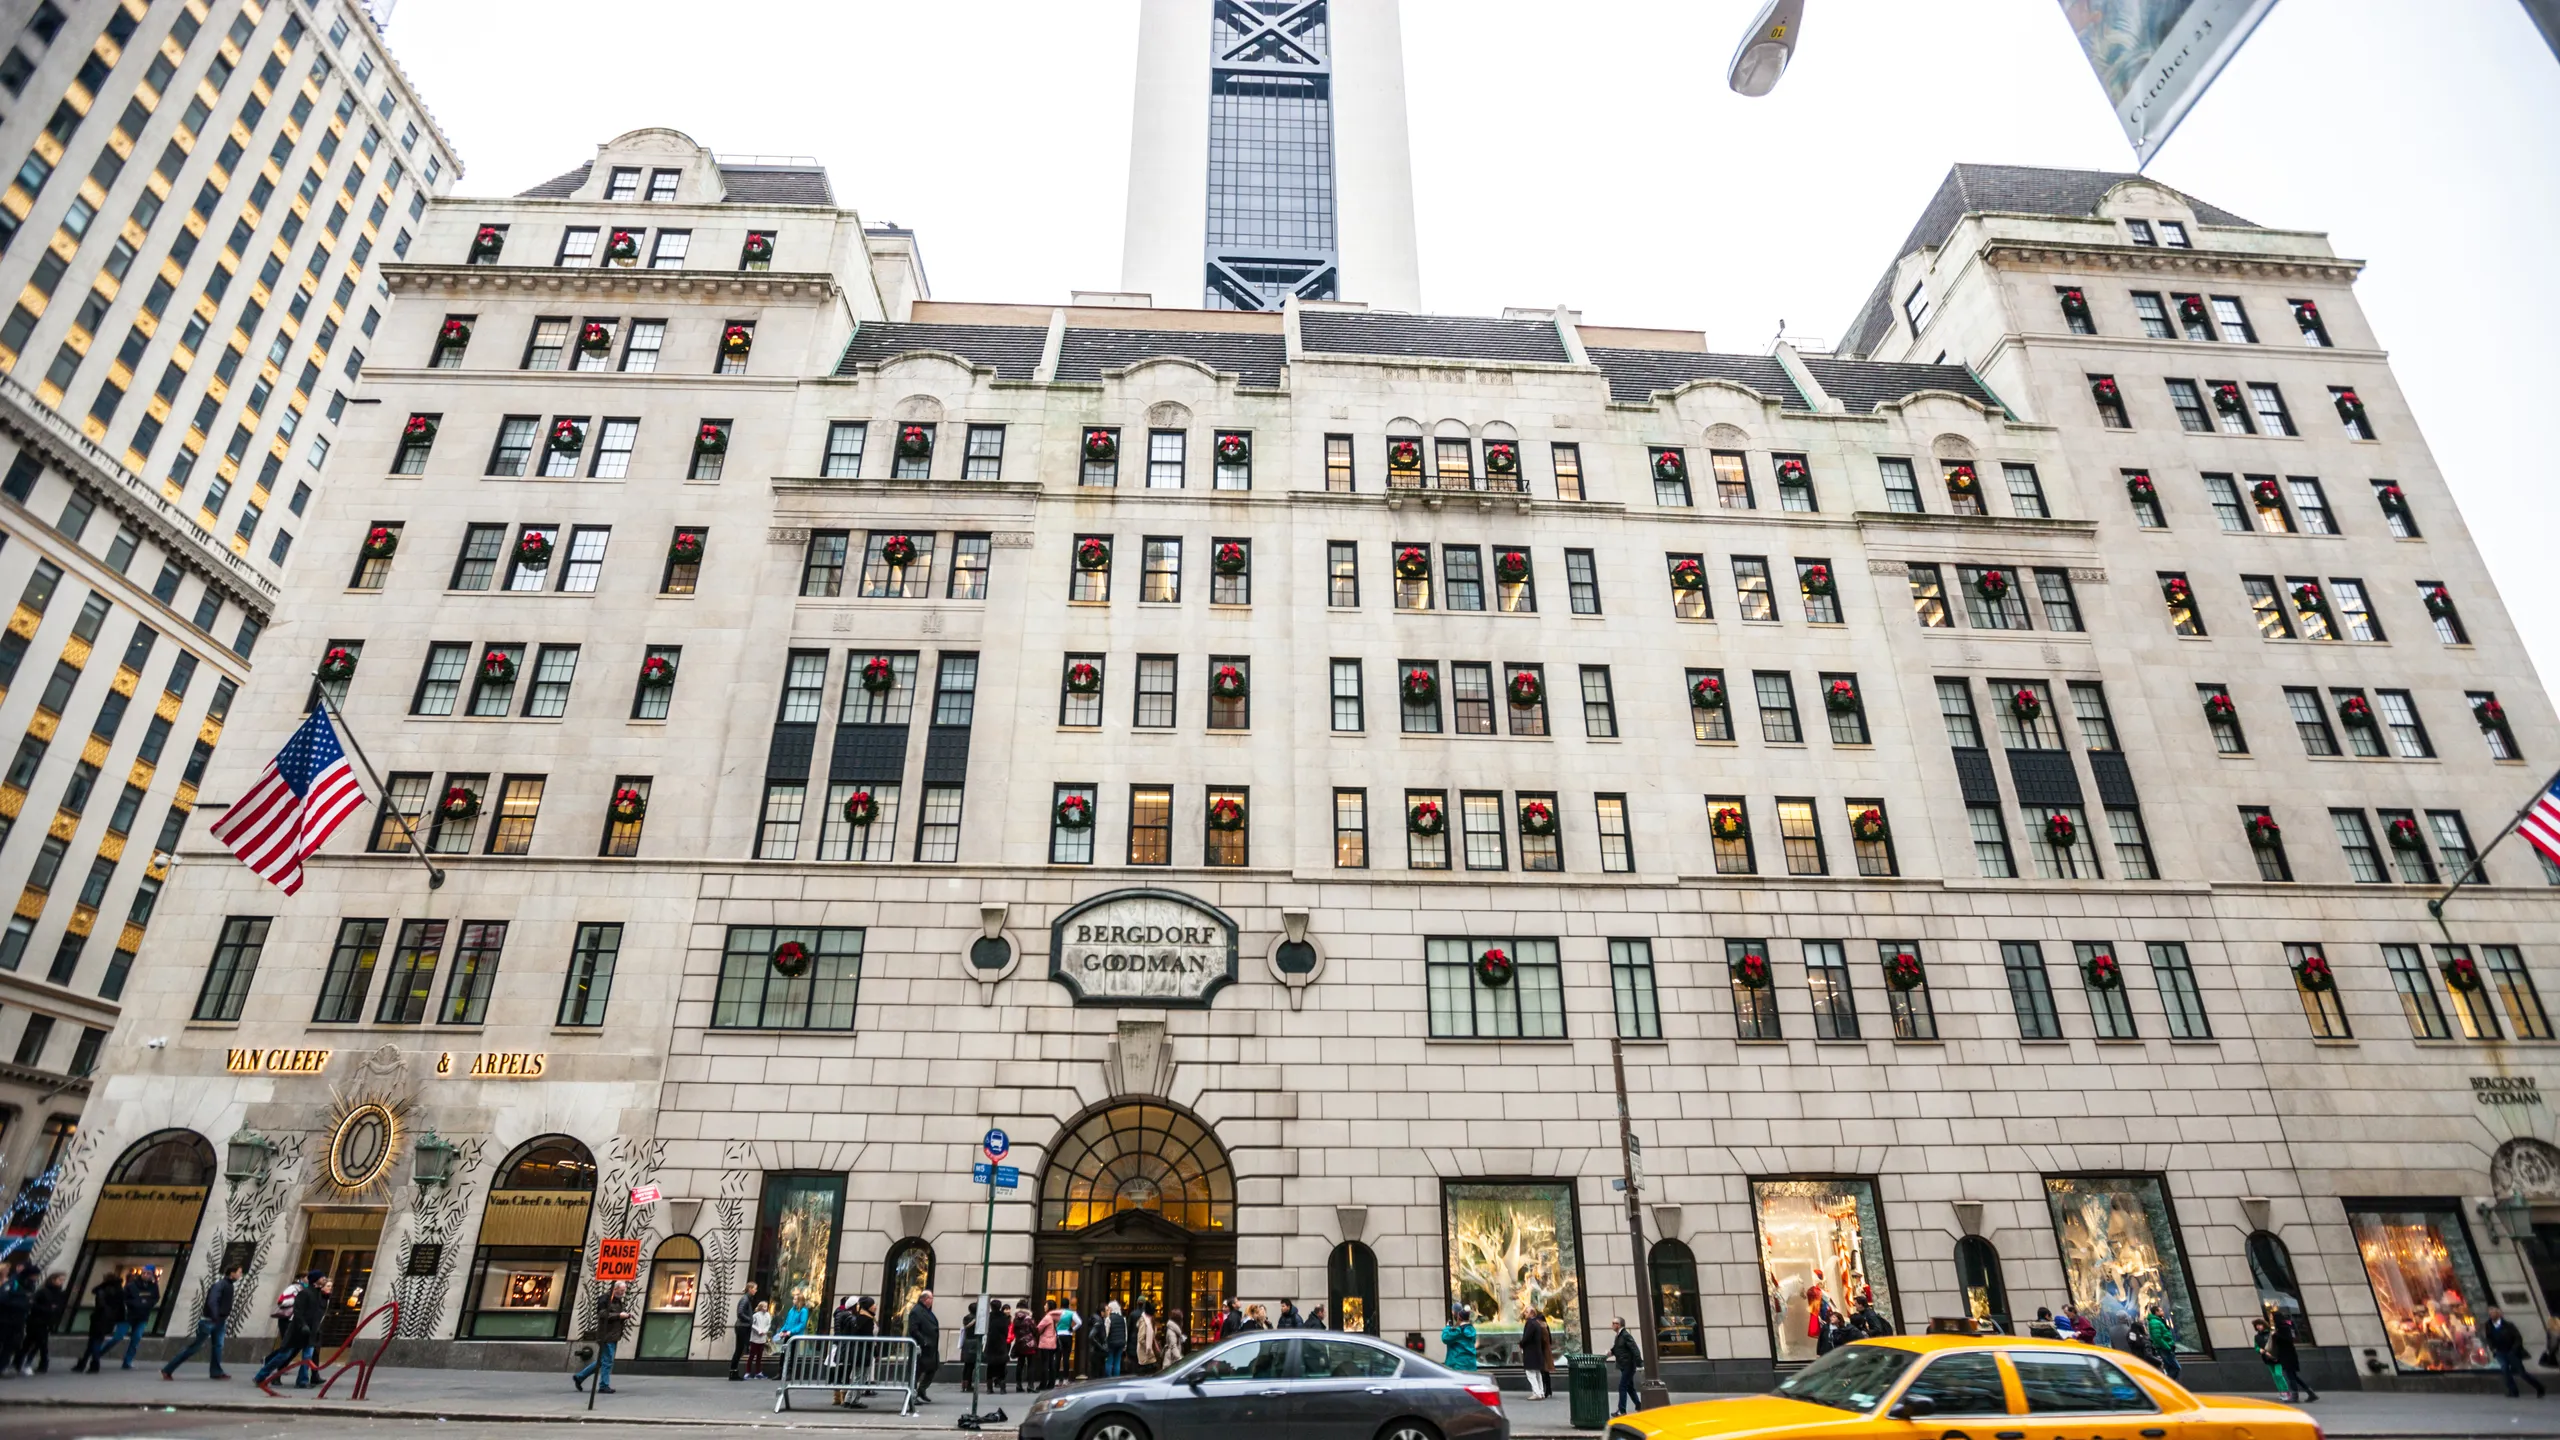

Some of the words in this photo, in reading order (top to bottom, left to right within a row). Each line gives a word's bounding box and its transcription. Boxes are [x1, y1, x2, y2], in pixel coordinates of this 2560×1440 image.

[2130, 45, 2191, 124] October
[1076, 925, 1216, 944] BERGDORF
[1083, 954, 1207, 973] GOODMAN
[226, 1049, 264, 1070] VAN
[266, 1049, 329, 1071] CLEEF
[437, 1052, 450, 1073] &
[470, 1053, 544, 1075] ARPELS
[2469, 1076, 2536, 1090] BERGDORF
[2477, 1092, 2543, 1105] GOODMAN
[490, 1195, 509, 1205] Van
[512, 1195, 542, 1206] Cleef
[554, 1195, 589, 1209] Arpels
[603, 1245, 637, 1258] RAISE
[600, 1261, 634, 1275] PLOW
